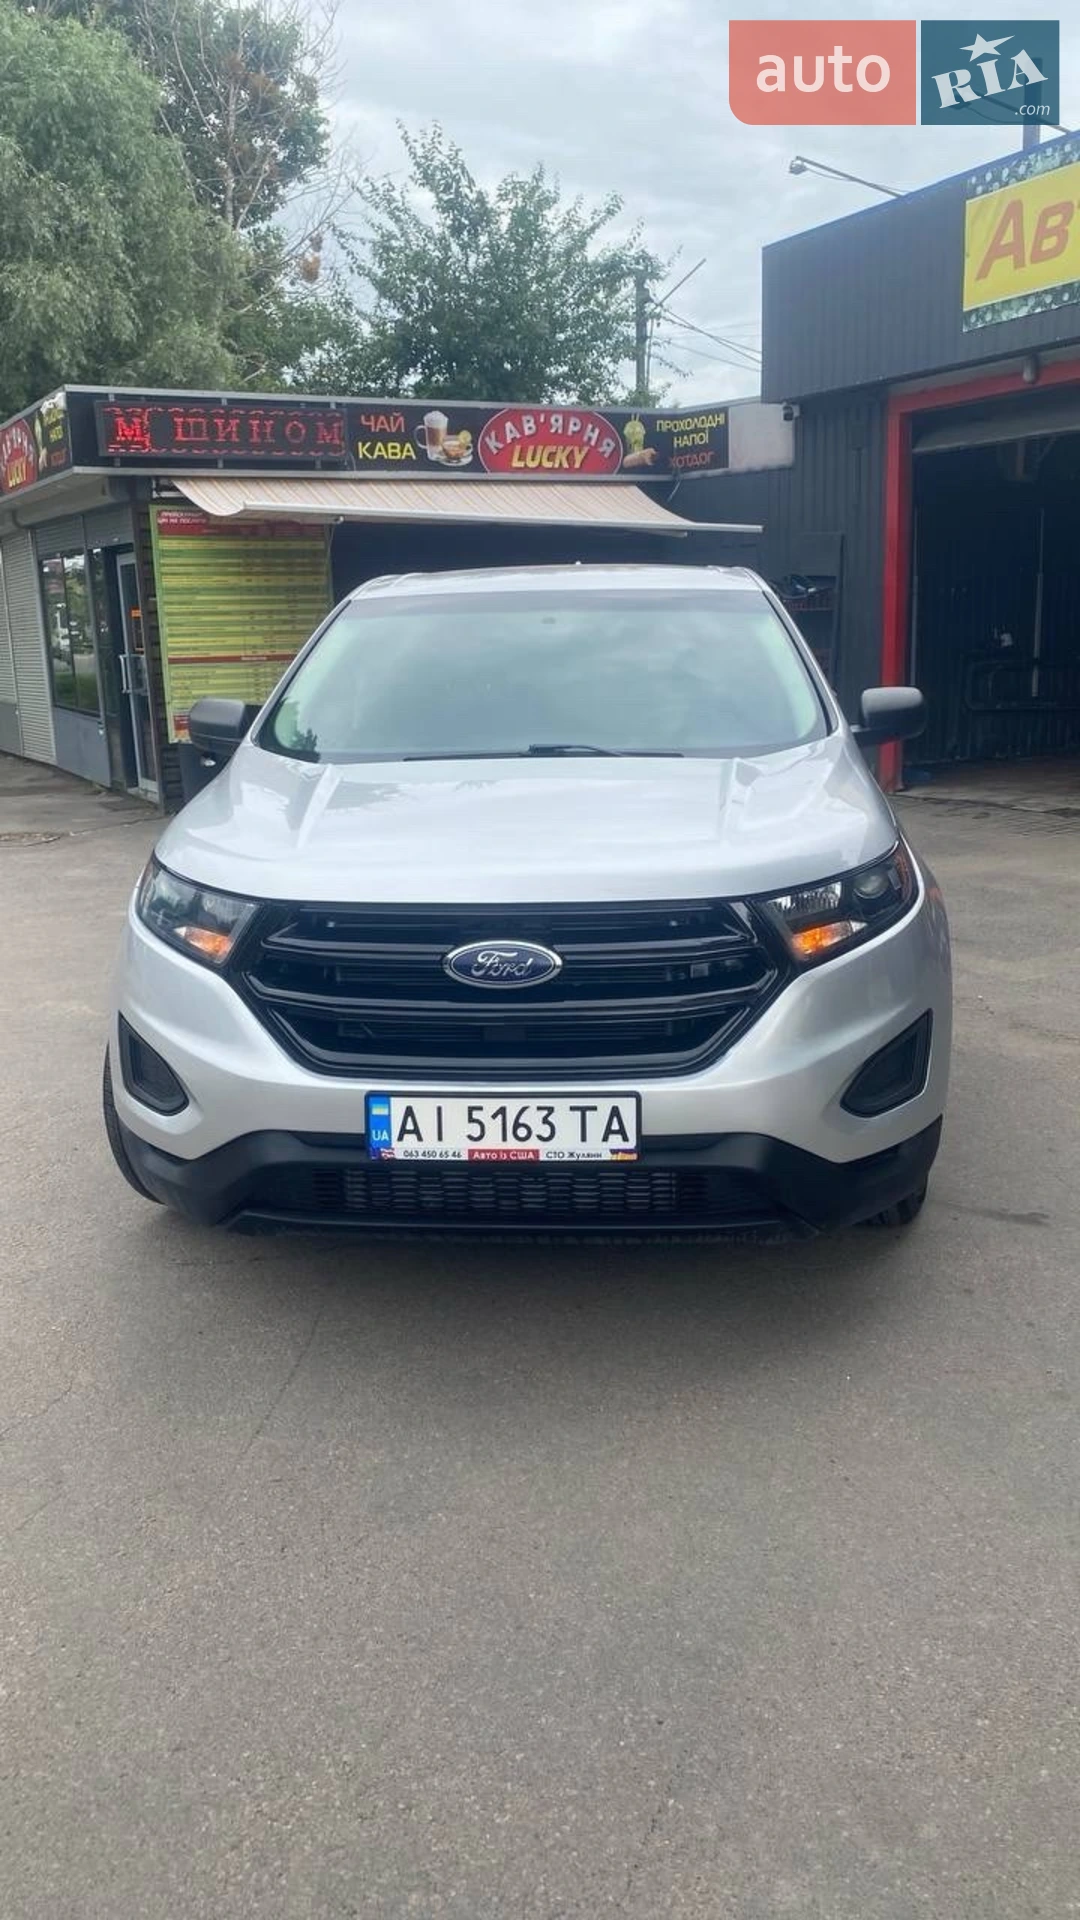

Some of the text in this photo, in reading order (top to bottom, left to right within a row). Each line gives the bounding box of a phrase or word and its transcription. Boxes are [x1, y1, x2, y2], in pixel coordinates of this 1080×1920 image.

[360, 412, 405, 433] ЧАЙ
[656, 413, 725, 432] ПРОХОЛОДНІ
[484, 413, 616, 458] КАВ'ЯРНЯ
[674, 427, 709, 448] НАПОЇ
[357, 442, 416, 461] КАВА
[511, 445, 590, 469] LUCKY
[471, 950, 534, 976] Ford
[397, 1105, 629, 1142] AI 5163 TA
[372, 1131, 389, 1141] UA
[403, 1150, 420, 1158] 063
[421, 1150, 439, 1158] 450
[472, 1151, 498, 1160] Авто
[509, 1151, 535, 1160] США
[546, 1151, 565, 1159] СТО
